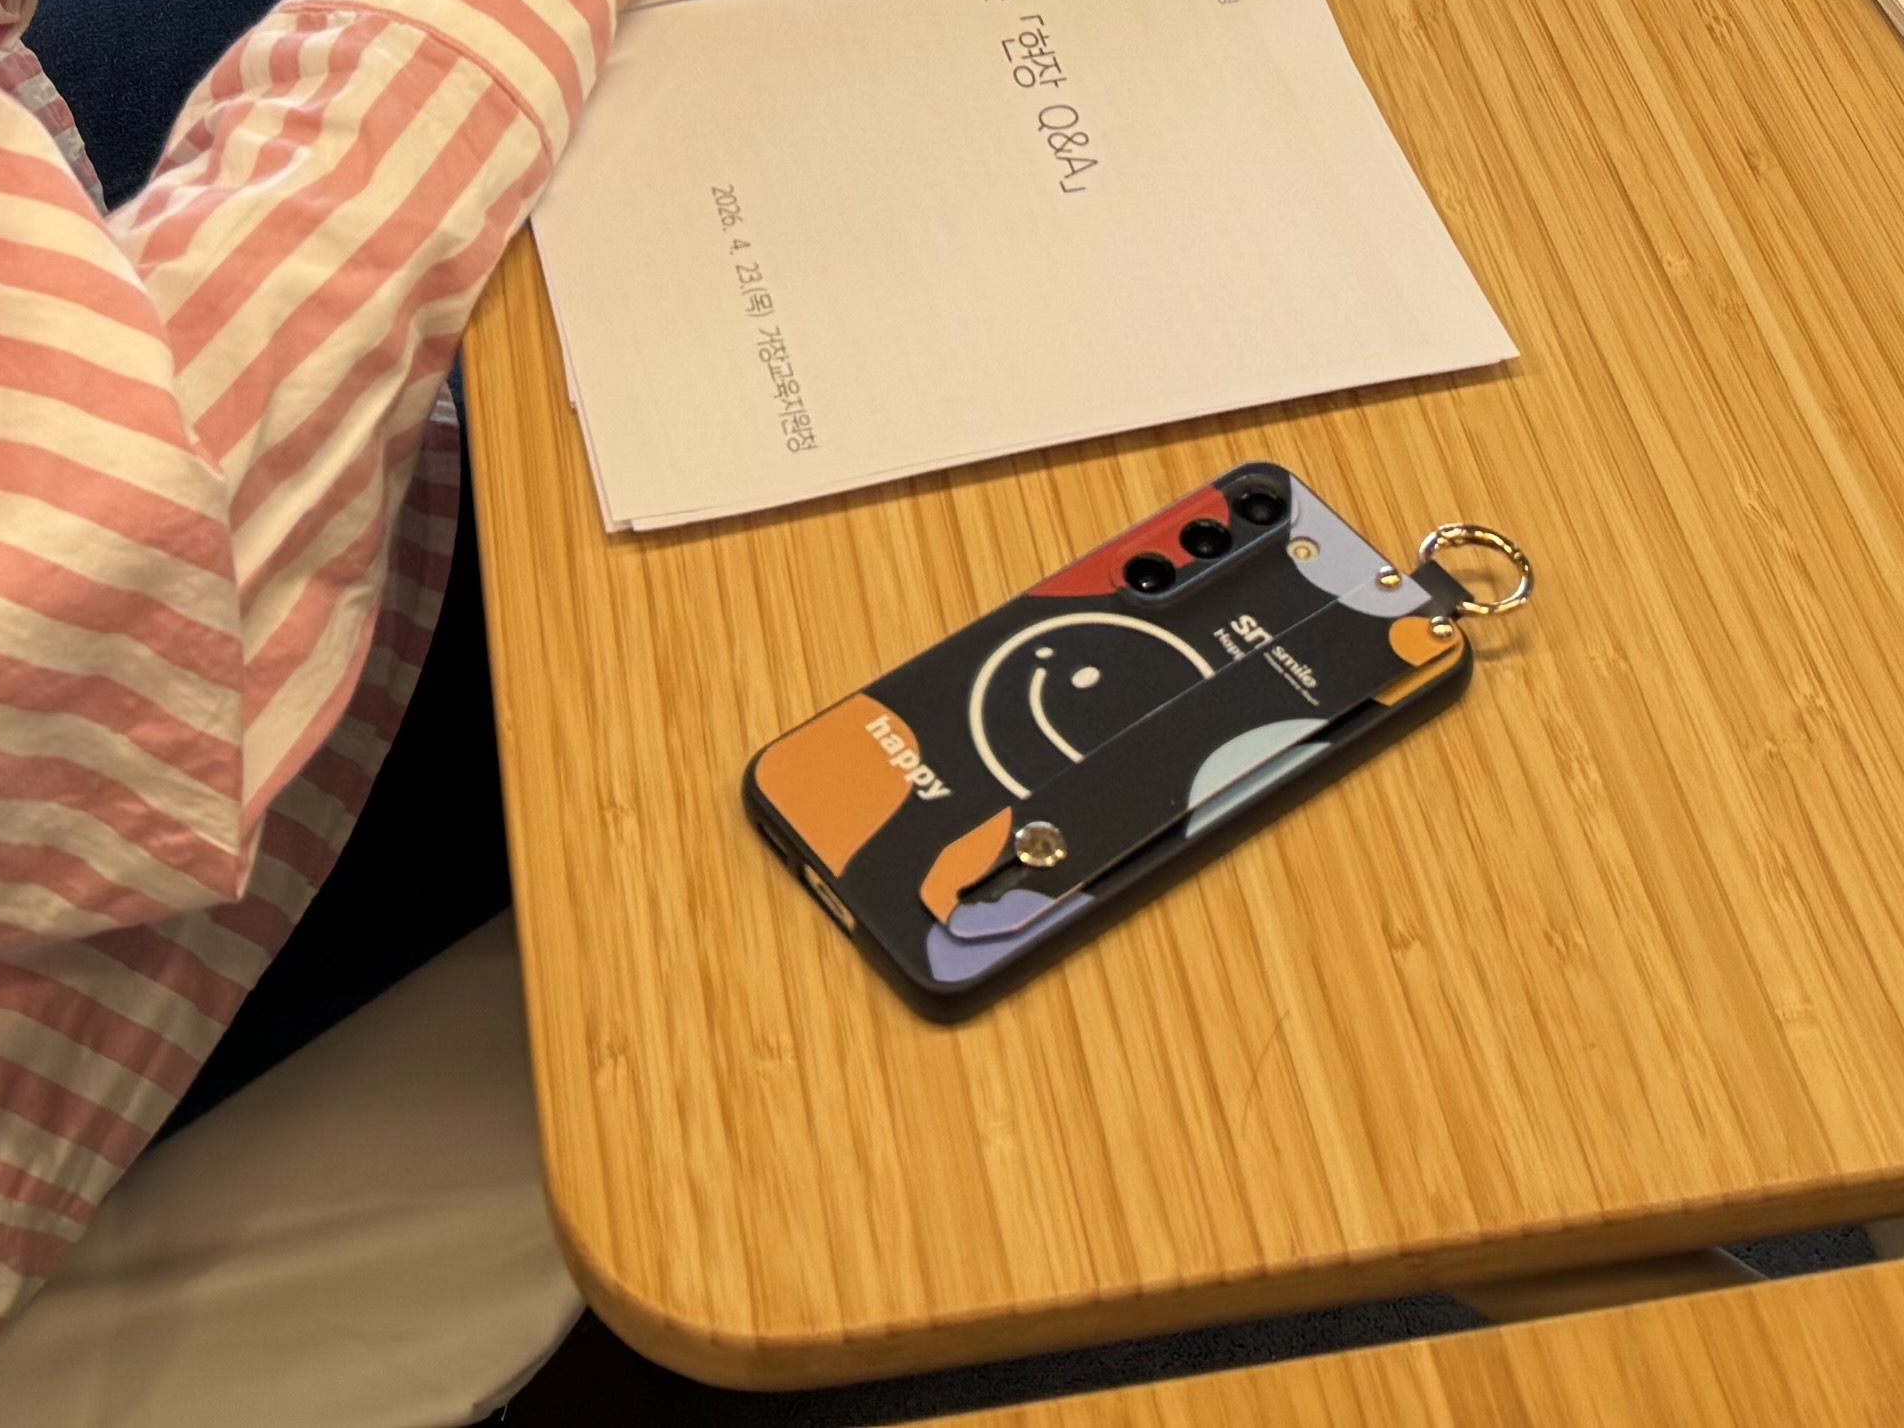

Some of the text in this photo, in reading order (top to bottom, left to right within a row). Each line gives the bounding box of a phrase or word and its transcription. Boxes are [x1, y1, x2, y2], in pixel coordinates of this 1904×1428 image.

[711, 184, 744, 232] 2026.
[729, 238, 751, 255] 4.
[757, 326, 819, 453] 거창교육지원청
[1271, 646, 1316, 688] smile
[863, 714, 953, 804] happy
